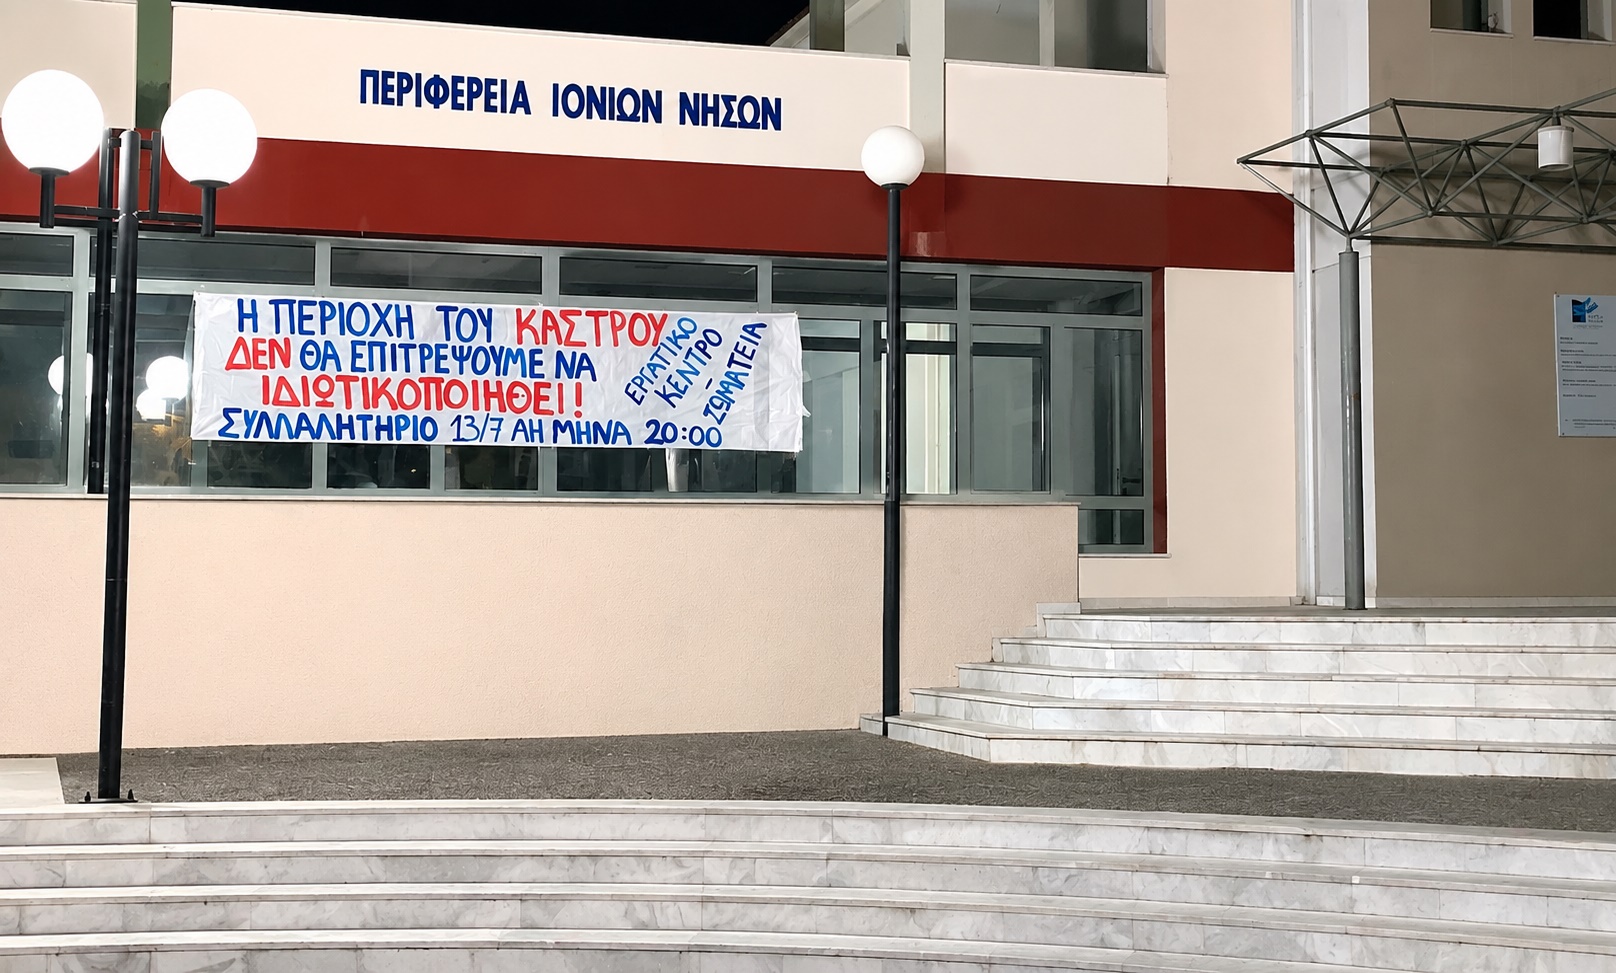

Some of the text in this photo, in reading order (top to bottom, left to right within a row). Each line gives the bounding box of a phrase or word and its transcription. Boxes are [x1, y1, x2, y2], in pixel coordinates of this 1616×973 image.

[360, 69, 782, 130] ΠΕΡΙΦΕΡΕΙΑ ΙΟΝΙΩΝ ΝΗΣΩΝ
[237, 298, 668, 347] Η ΠΕΡΙΟΧΗ ΤΟΥ ΚΑΣΤΡΟΥ
[225, 337, 597, 381] ΔΕΝ ΘΑ ΕΠΙΤΡΕΨΟΥΜΕ ΝΑ
[625, 317, 698, 406] ΕΡΓΑΤΙΚΟ
[654, 328, 723, 409] ΚΕΝΤΡΟ
[262, 374, 583, 418] ΙΔΙΩΤΙΚΟΠΟΙΗΘΕΙ!
[218, 408, 438, 442] ΣΥΛΛΑΛΗΤΗΡΙΟ
[450, 413, 505, 442] 13/7
[552, 419, 632, 446] ΜΗΝΑ
[644, 419, 723, 448] 20:00
